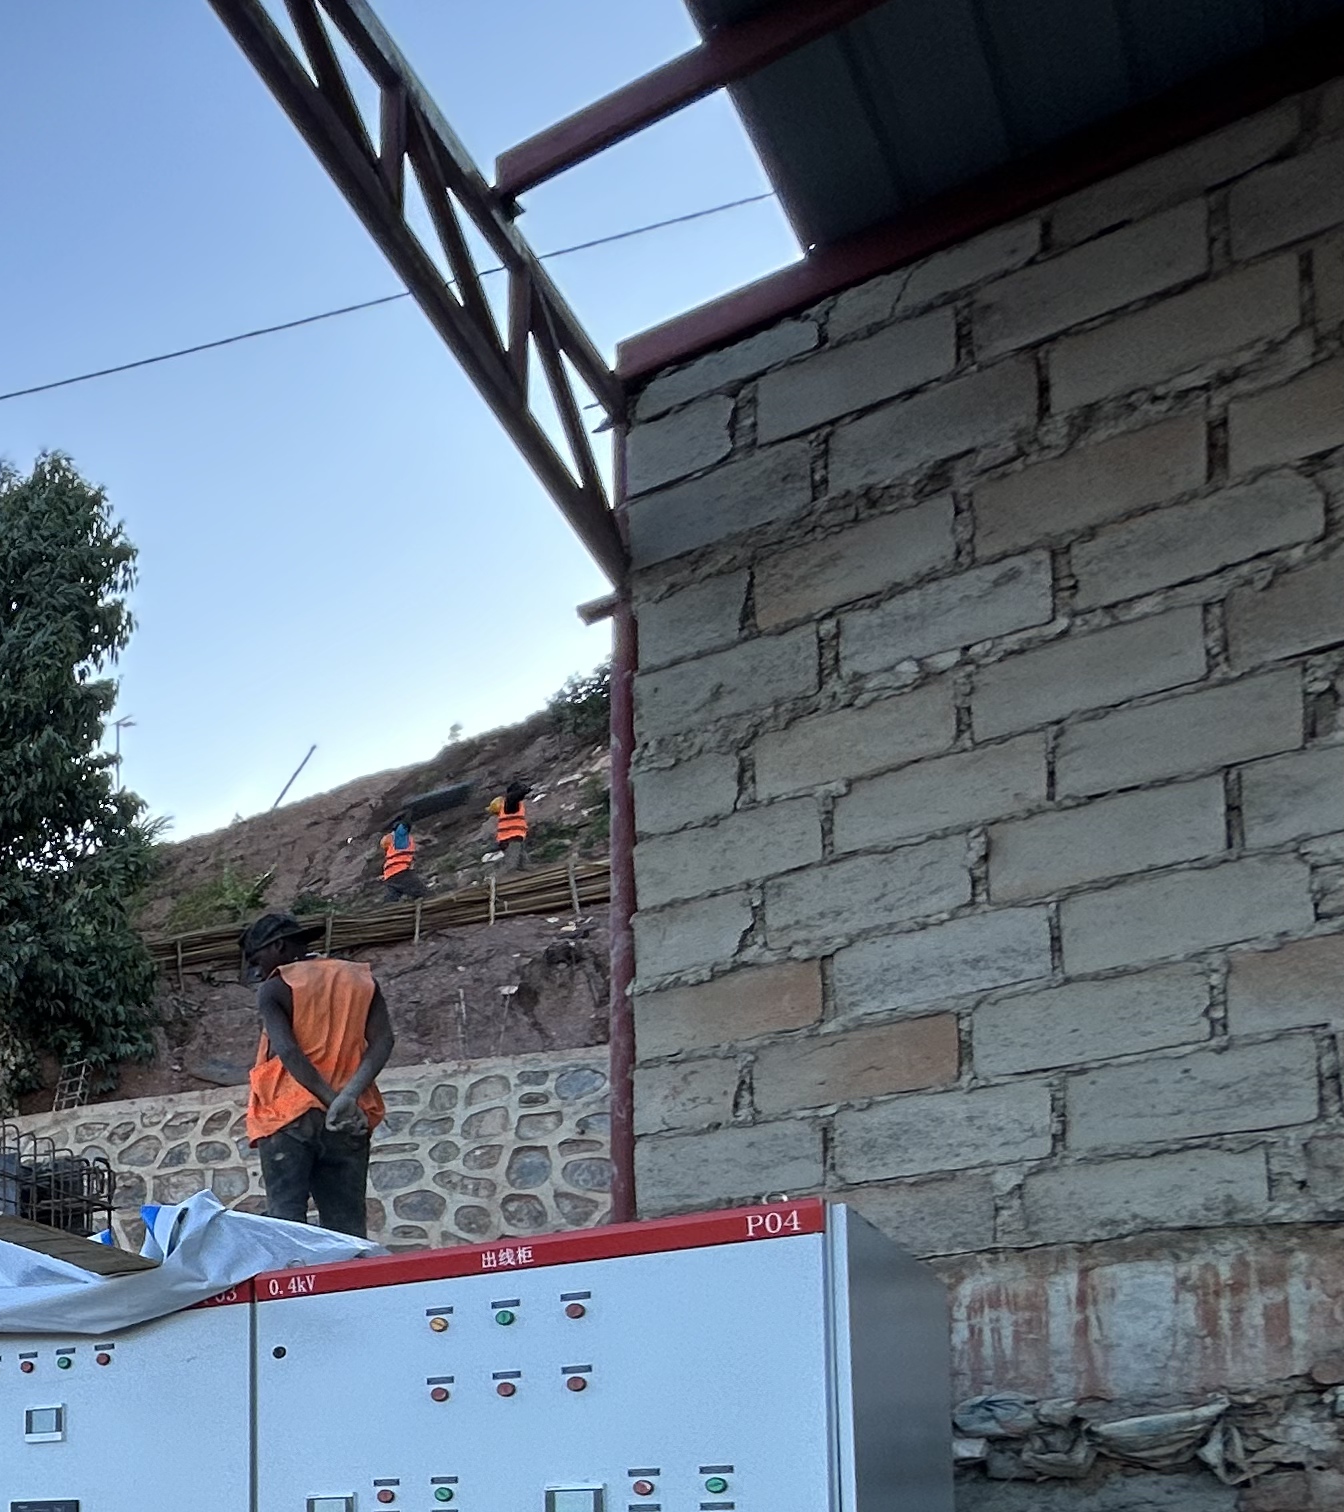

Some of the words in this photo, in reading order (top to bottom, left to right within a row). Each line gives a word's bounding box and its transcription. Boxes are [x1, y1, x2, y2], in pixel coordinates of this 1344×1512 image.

[745, 1210, 801, 1237] P04
[480, 1246, 534, 1269] 出线柜
[268, 1274, 316, 1297] 0.4kV
